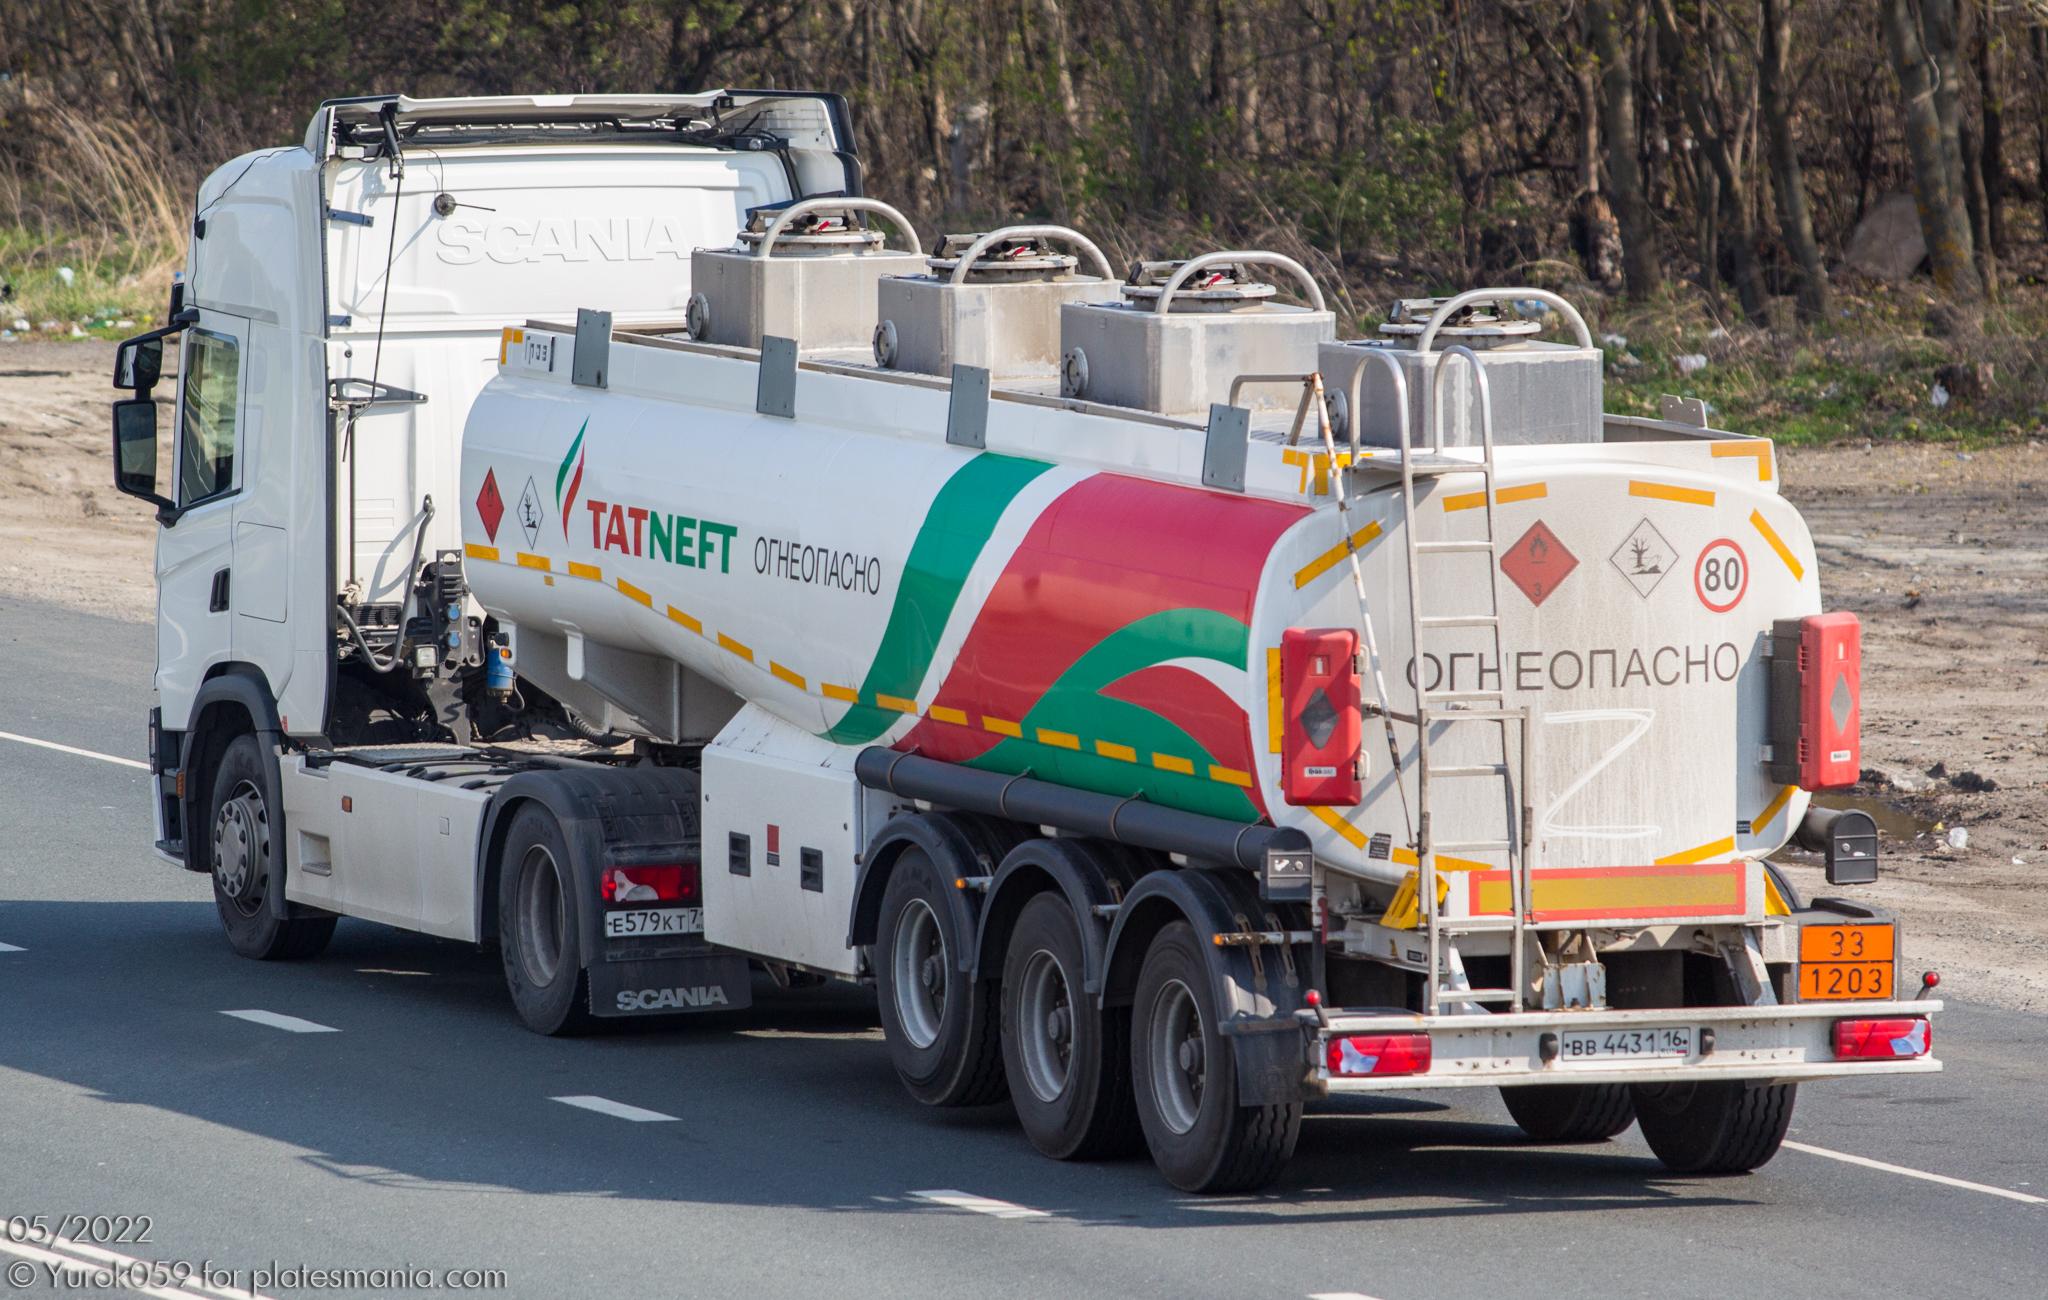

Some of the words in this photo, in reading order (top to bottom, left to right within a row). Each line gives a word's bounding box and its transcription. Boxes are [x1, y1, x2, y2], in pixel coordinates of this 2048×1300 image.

[436, 216, 691, 266] SCANIA
[586, 499, 738, 574] TATNEFT
[754, 536, 881, 596] ОГНЕОПАСНО
[1704, 556, 1740, 593] 80
[1406, 642, 1740, 692] ОГНЕОПАСНО
[1541, 708, 1662, 839] Z
[690, 909, 704, 925] 7
[1830, 930, 1864, 957] 33
[616, 985, 729, 1011] SCANIA
[1812, 968, 1883, 995] 1203
[1603, 1032, 1655, 1055] 4431
[1663, 1030, 1682, 1047] 16
